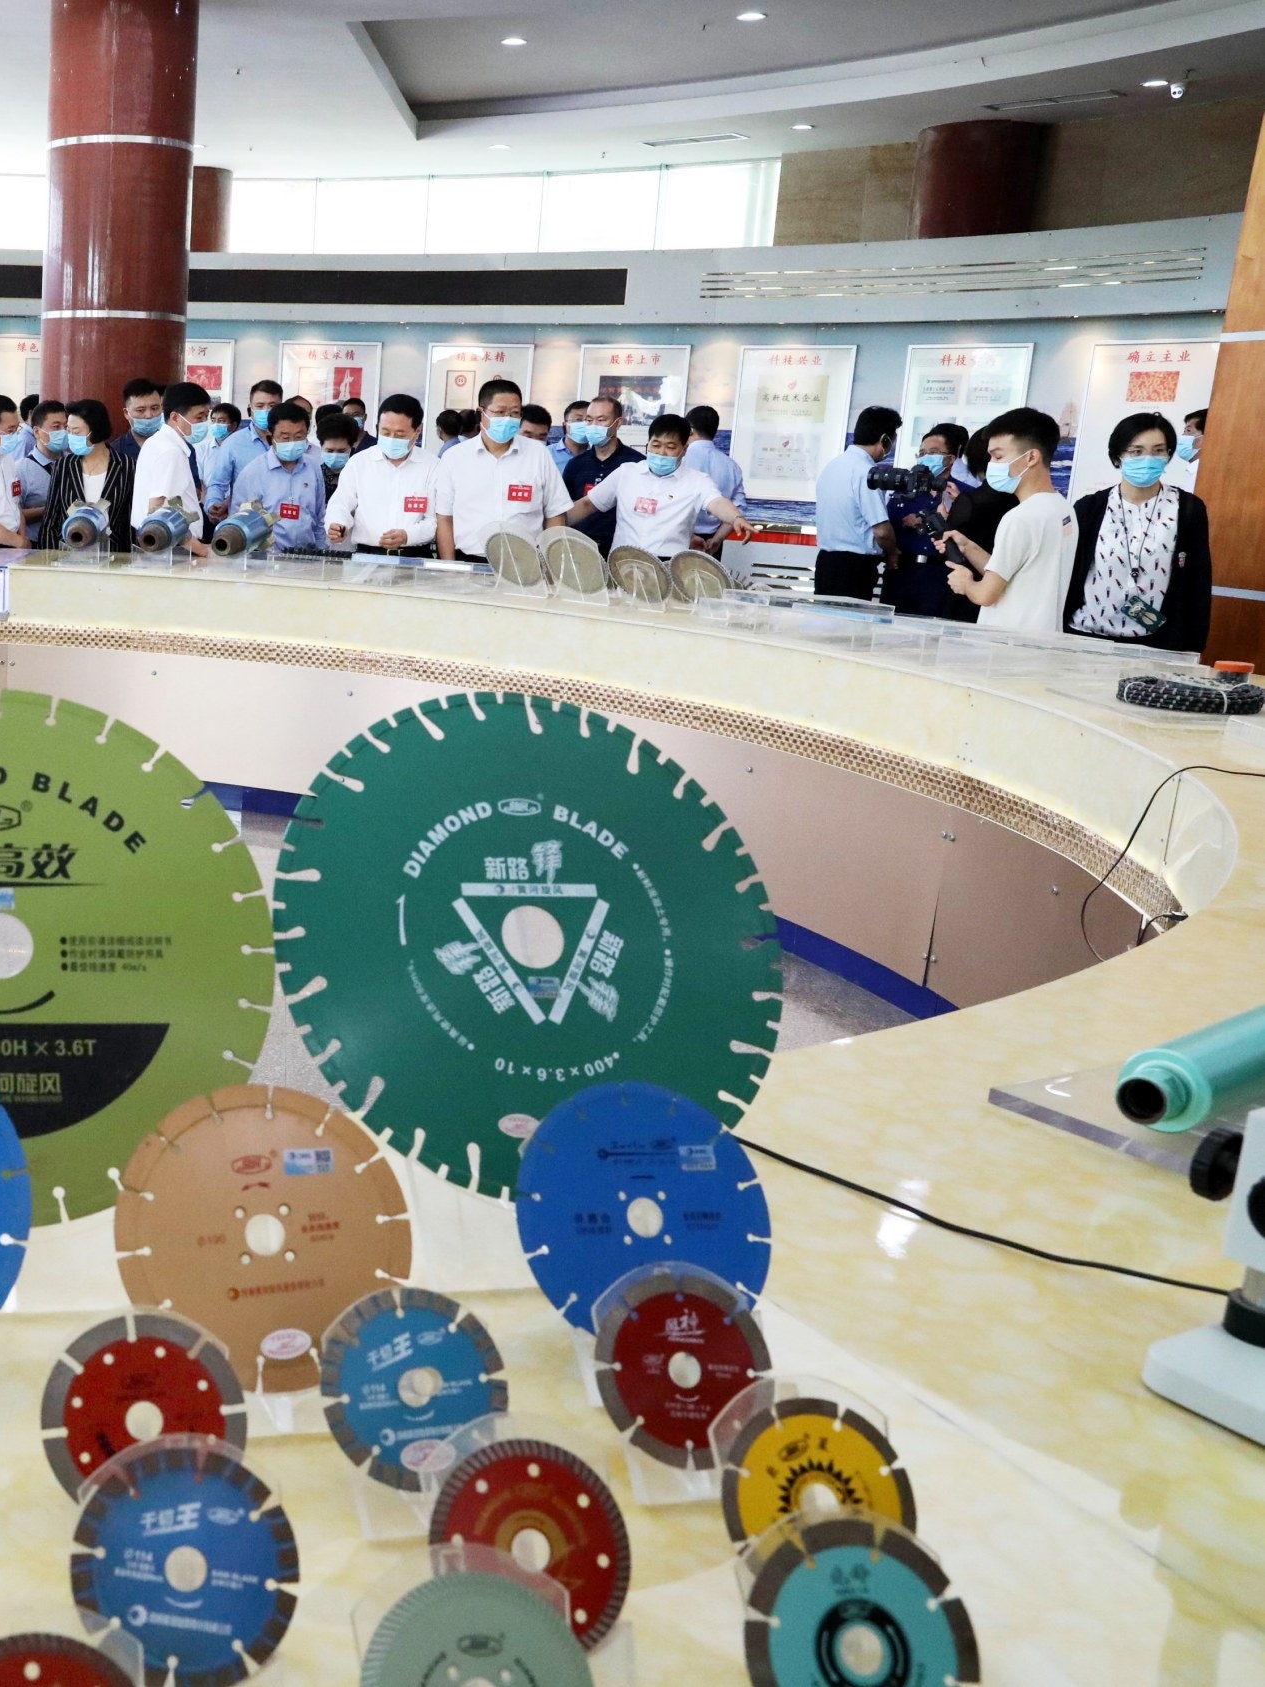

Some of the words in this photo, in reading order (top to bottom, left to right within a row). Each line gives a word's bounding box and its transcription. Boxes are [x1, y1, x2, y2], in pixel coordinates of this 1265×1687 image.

[609, 353, 662, 366] 股票上市
[769, 354, 823, 367] 科技兴业
[1126, 350, 1191, 363] 确立主业
[31, 771, 148, 854] BLADE
[403, 801, 493, 879] DIAMOND
[553, 804, 630, 861] BLADE
[54, 1039, 97, 1056] 3.6T
